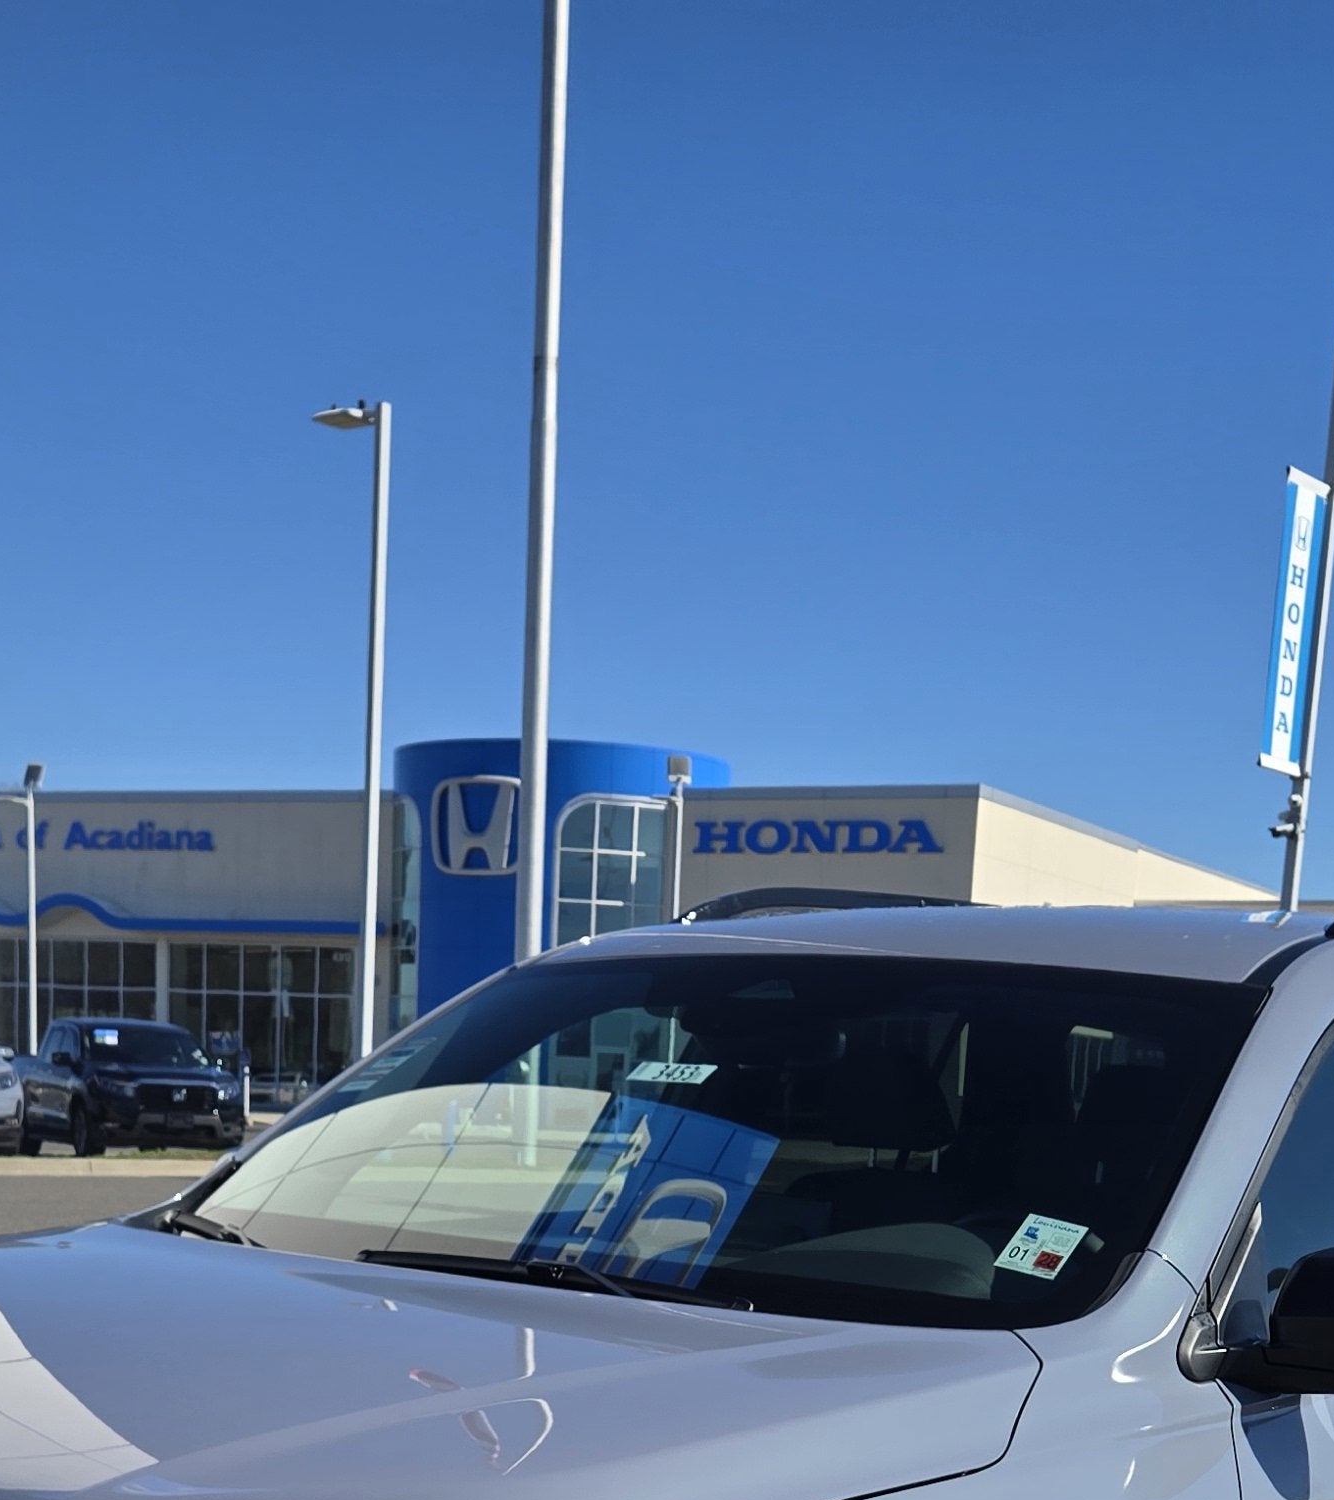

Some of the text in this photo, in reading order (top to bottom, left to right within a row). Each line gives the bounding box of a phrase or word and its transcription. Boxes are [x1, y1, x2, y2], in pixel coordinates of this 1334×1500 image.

[1275, 564, 1305, 734] HONDA
[17, 819, 50, 849] of
[64, 820, 215, 851] Acadiana
[693, 819, 944, 854] HONDA
[1008, 1246, 1029, 1261] 01
